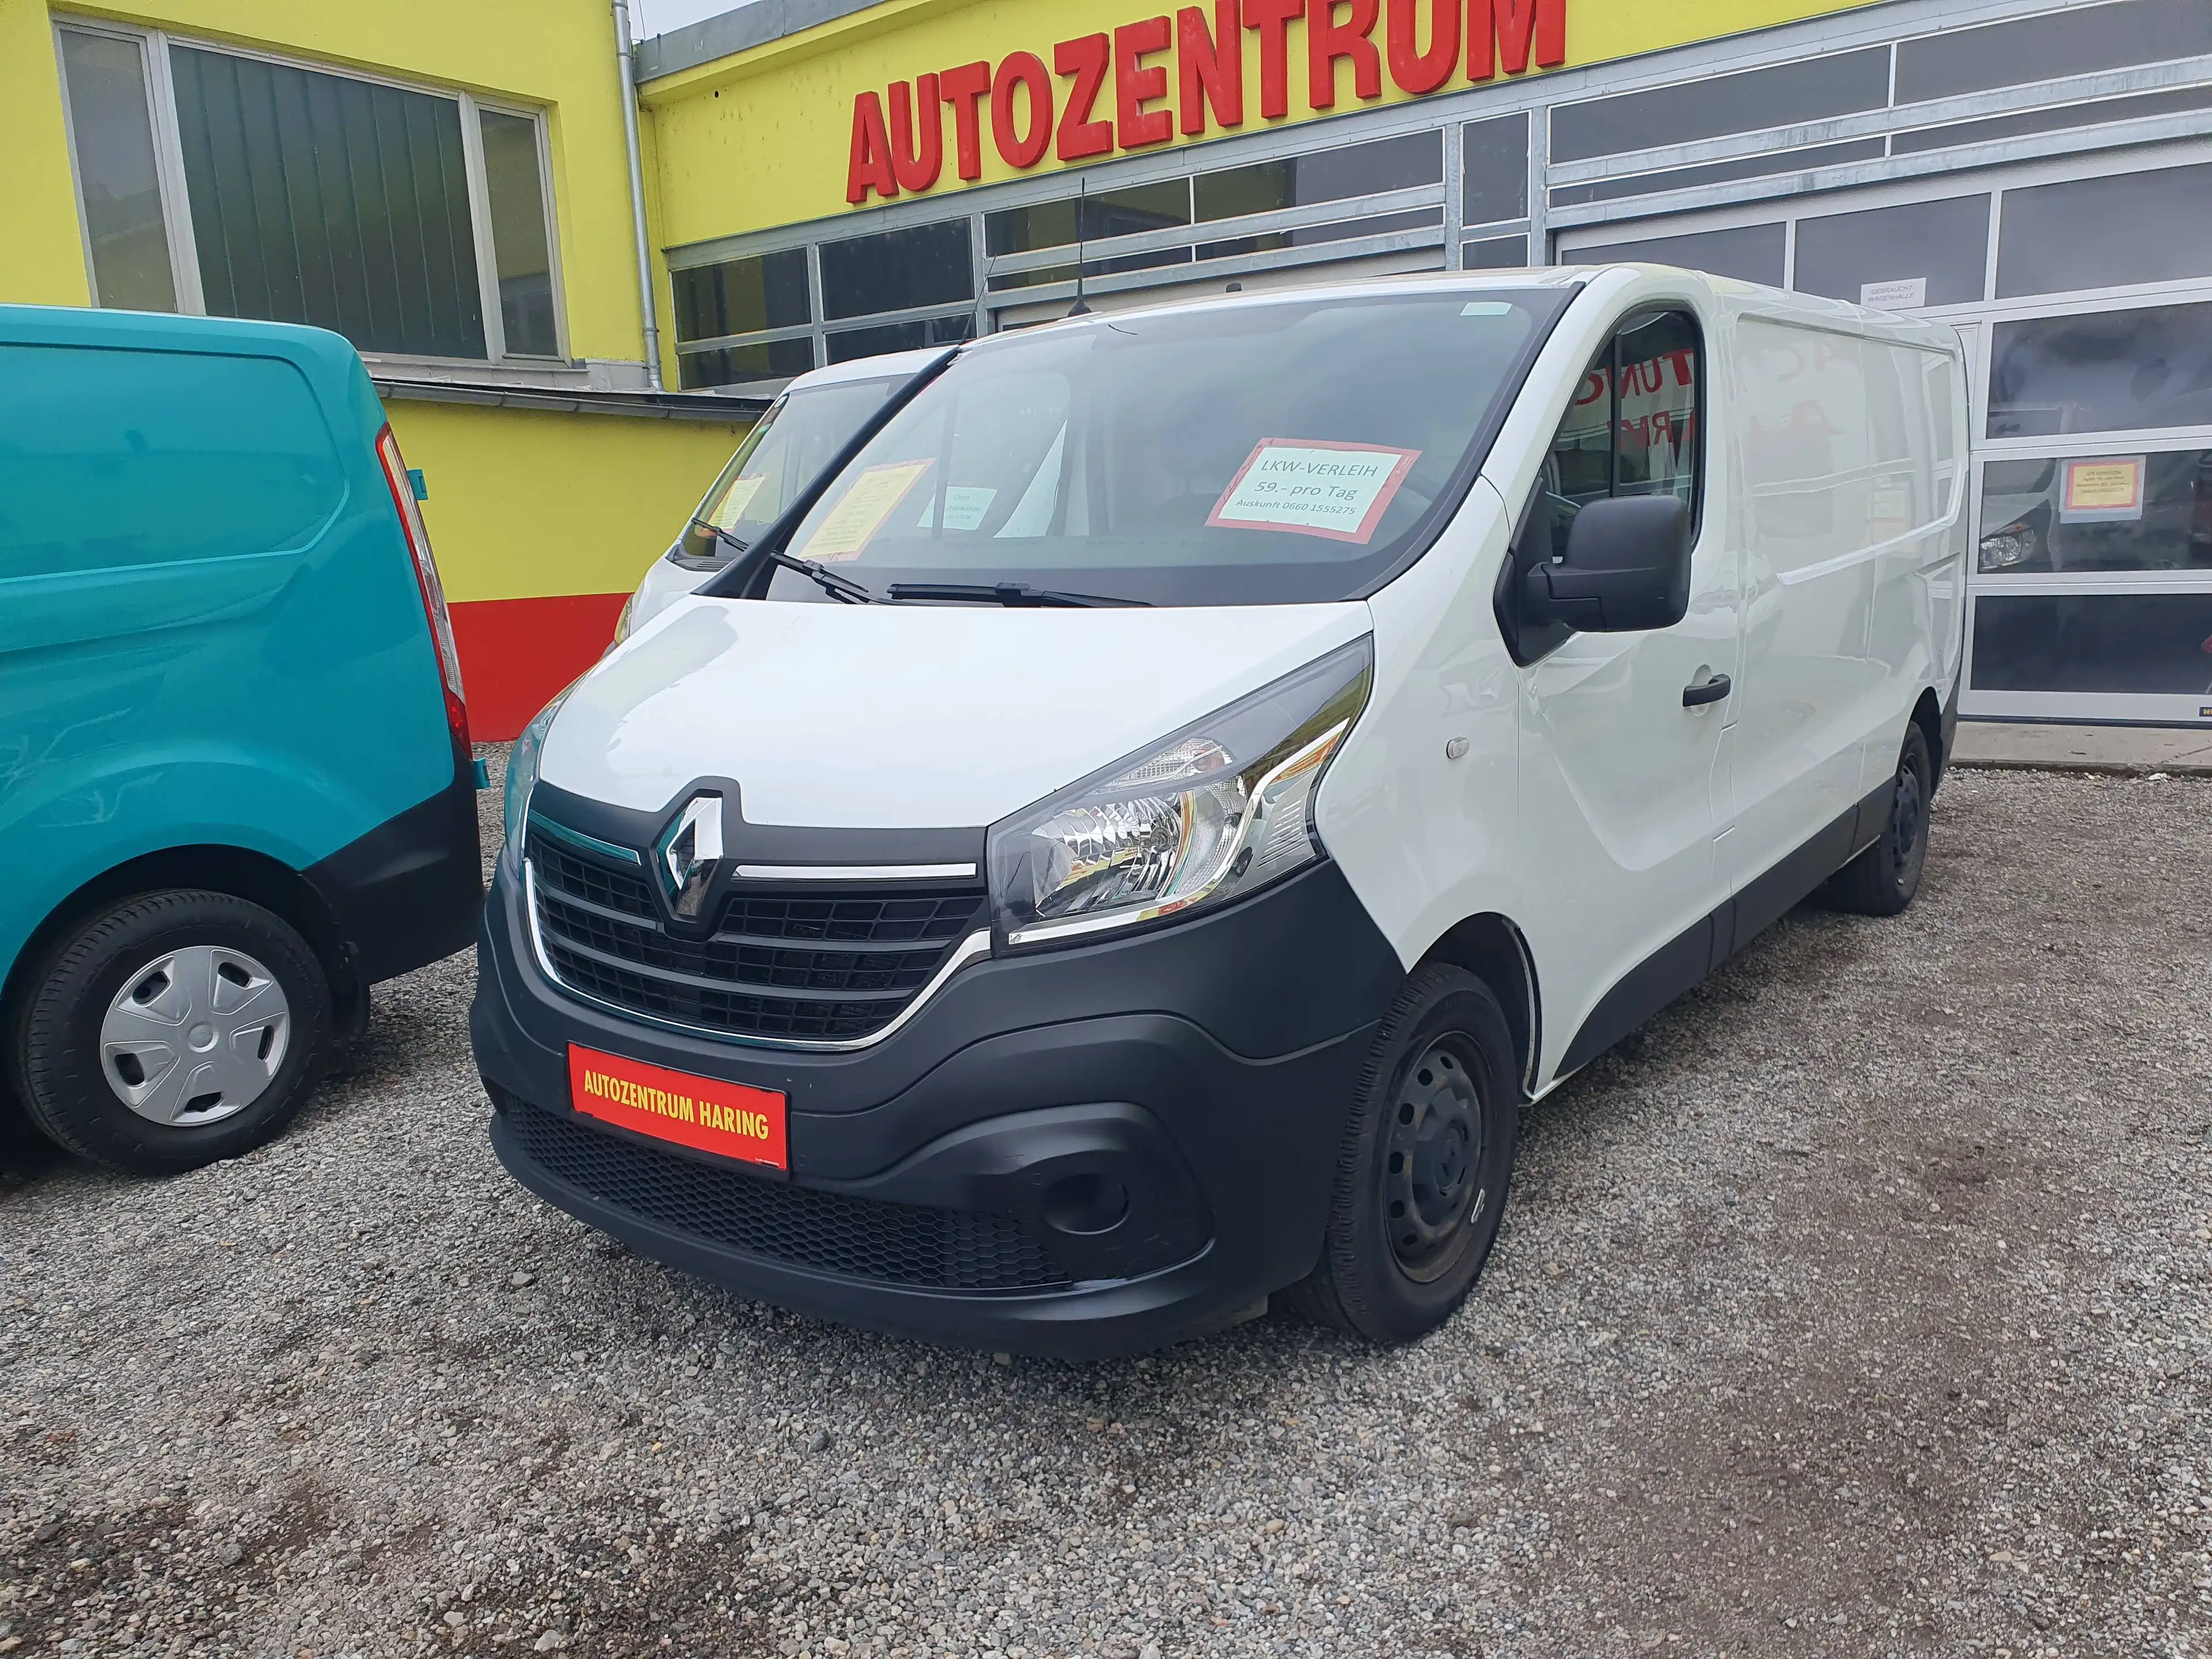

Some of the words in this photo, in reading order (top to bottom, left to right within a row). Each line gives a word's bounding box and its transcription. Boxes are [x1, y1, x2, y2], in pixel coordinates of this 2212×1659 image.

[845, 0, 1566, 204] AUTOZENTRUM
[1868, 292, 1914, 302] WAGENHALLE
[1262, 460, 1377, 477] LKW-VERLEIH
[1289, 486, 1321, 497] pro
[1328, 486, 1358, 501] Tag
[1235, 498, 1281, 509] Auskunft
[1282, 501, 1309, 512] 0660
[1310, 503, 1356, 516] 1555275
[584, 1069, 695, 1124] AUTOZENTRUM
[699, 1100, 769, 1141] HARING
